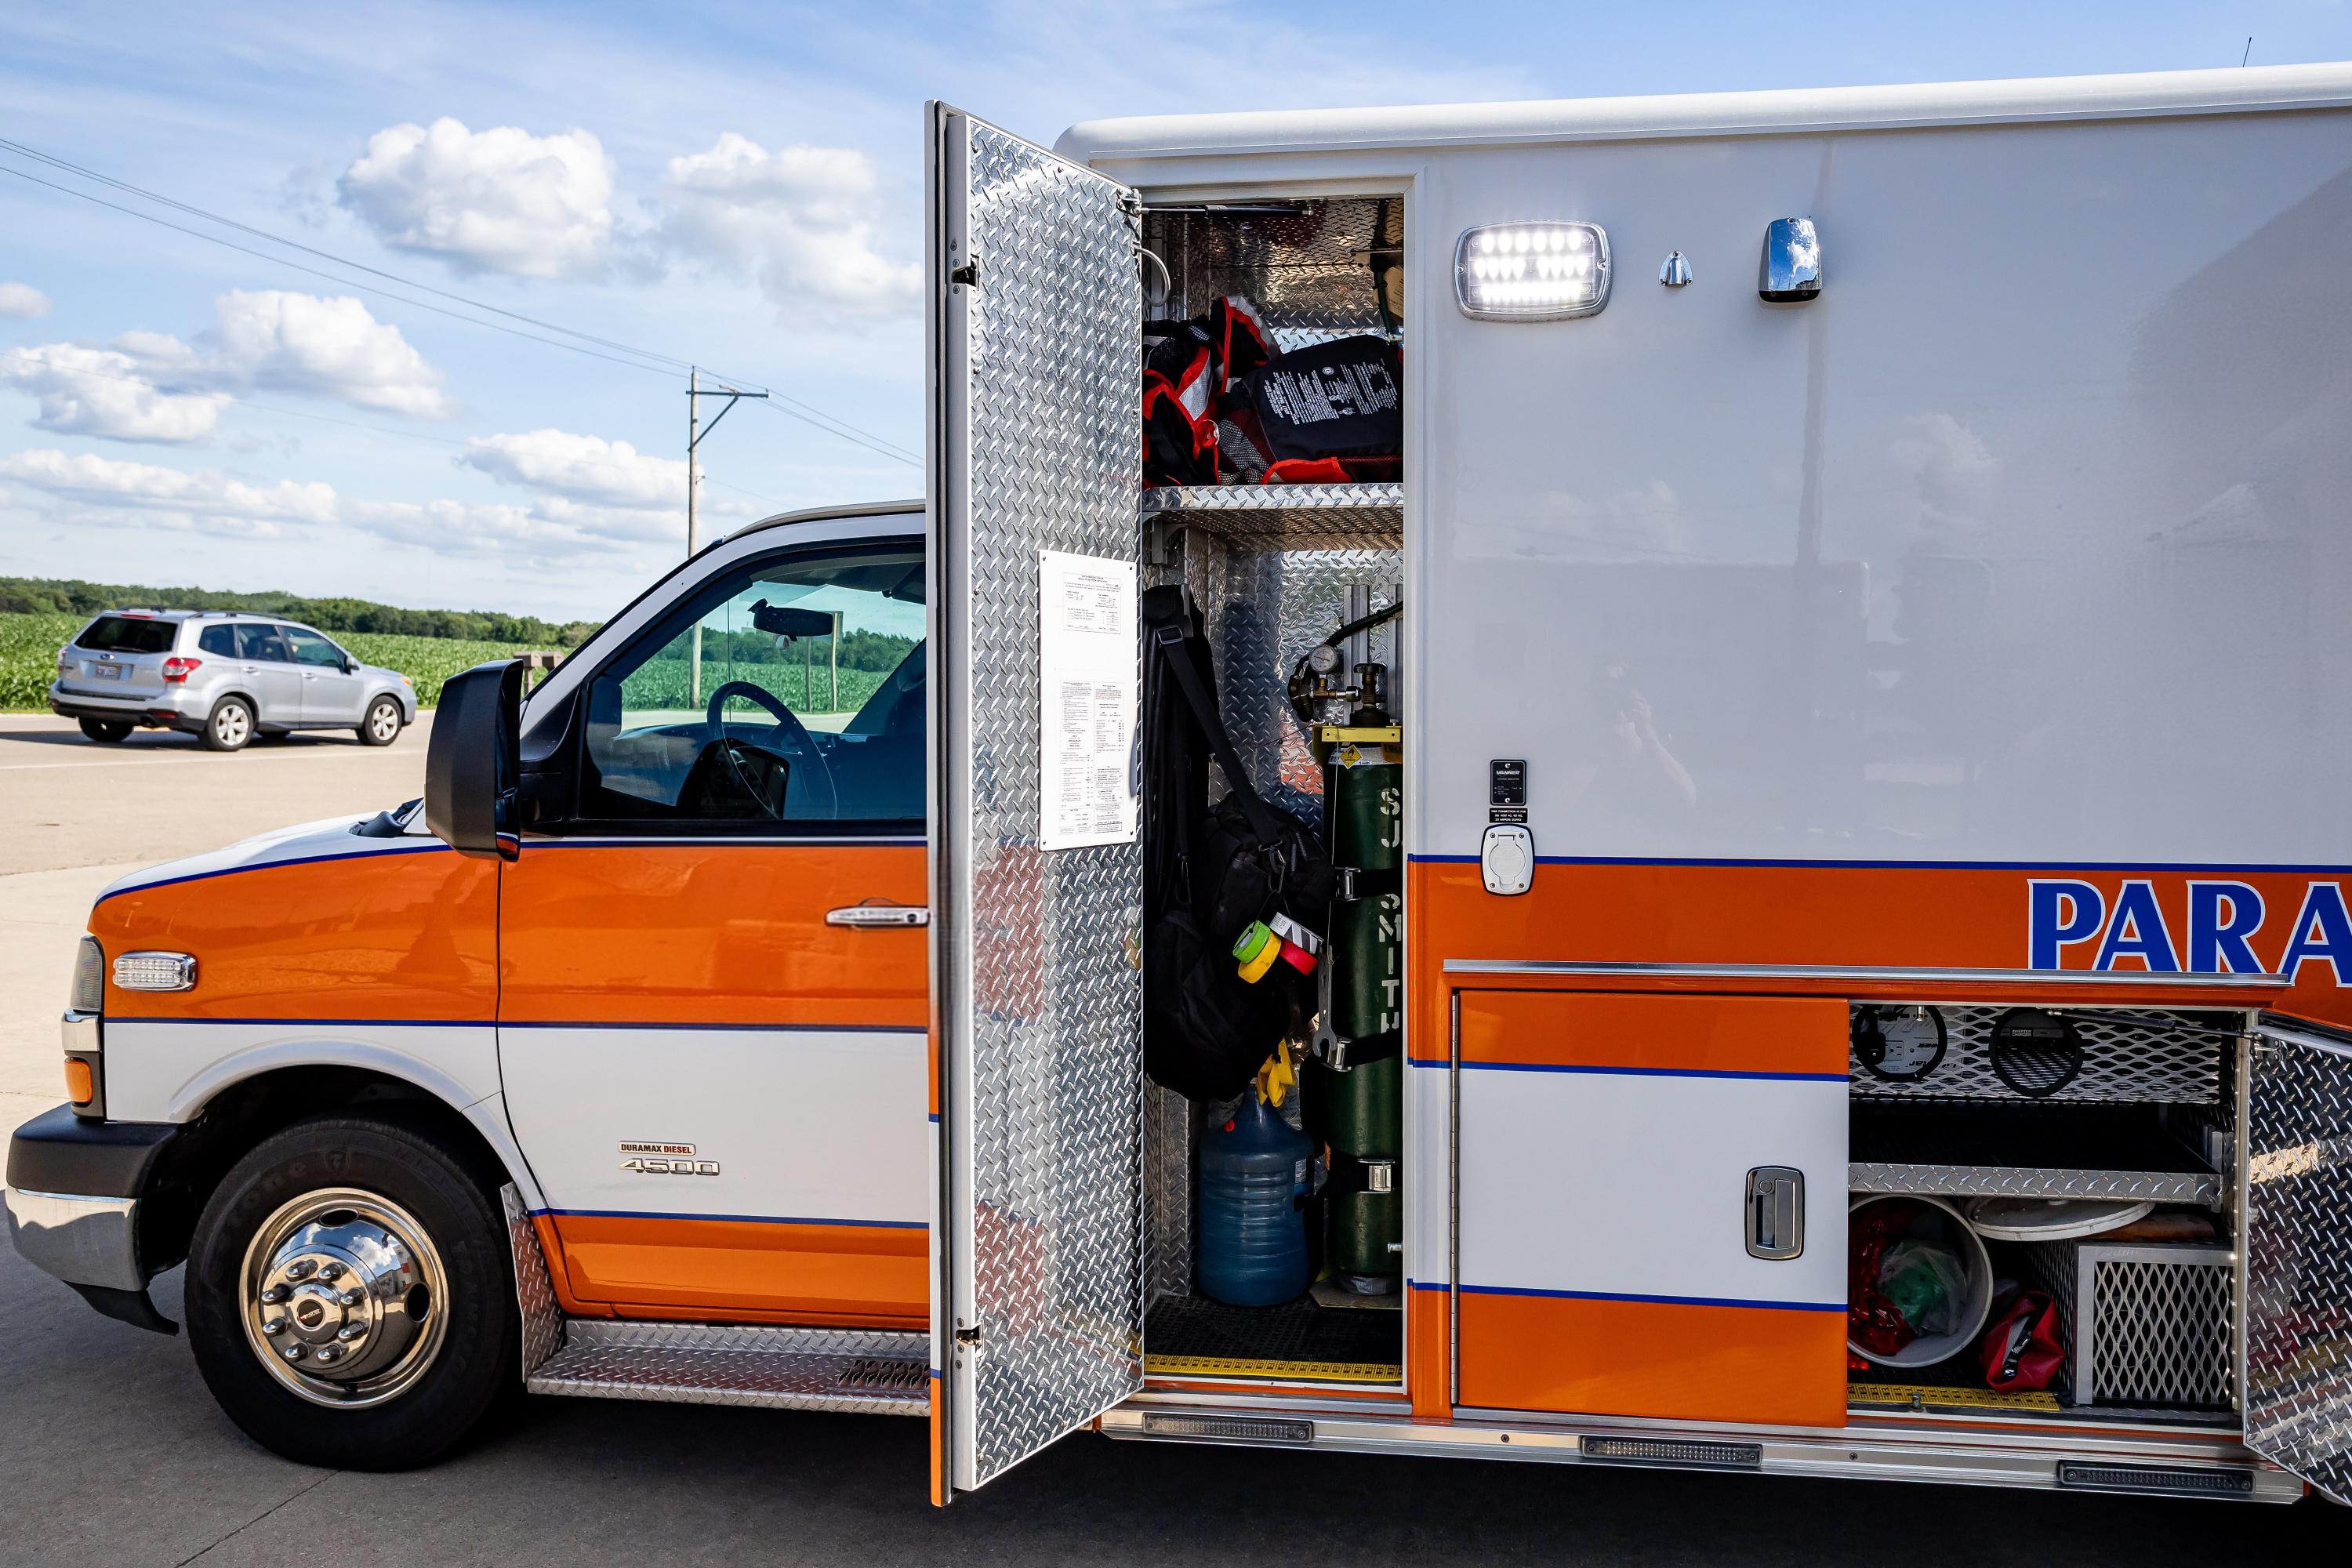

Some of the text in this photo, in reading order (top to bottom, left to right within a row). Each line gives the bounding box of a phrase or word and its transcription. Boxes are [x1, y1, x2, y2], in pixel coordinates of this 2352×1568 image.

[2027, 878, 2352, 987] PARA
[621, 1144, 692, 1154] DURAMAX DIESEL
[618, 1157, 720, 1176] 4500
